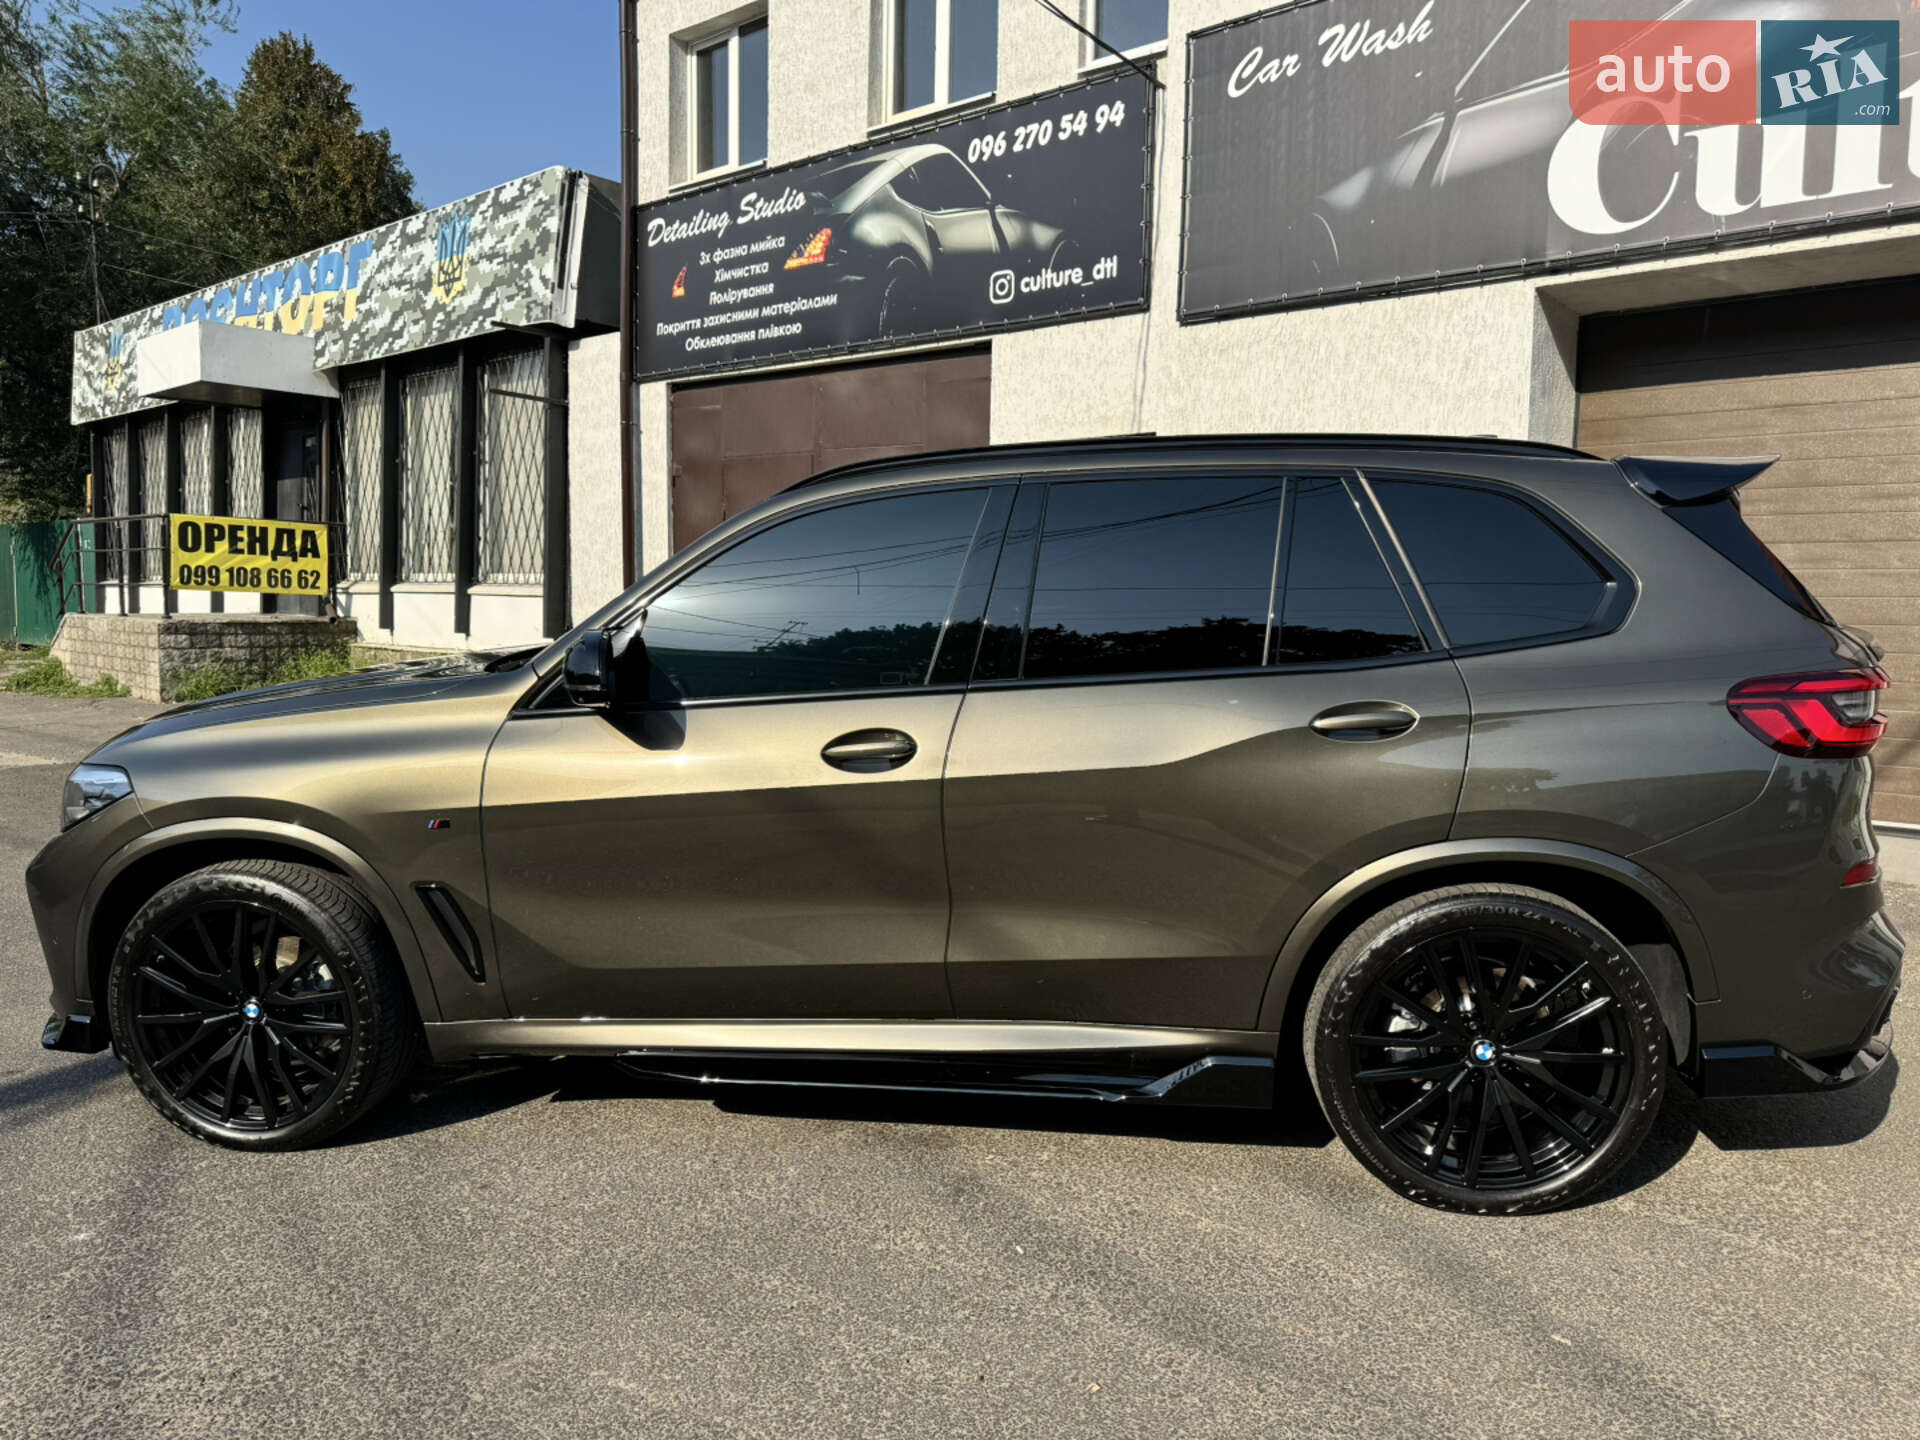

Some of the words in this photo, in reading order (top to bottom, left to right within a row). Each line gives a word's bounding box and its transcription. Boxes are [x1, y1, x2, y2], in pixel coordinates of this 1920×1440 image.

[1227, 46, 1301, 98] Car
[1318, 0, 1434, 67] Wash
[967, 130, 1007, 164] 096
[1012, 119, 1053, 152] 270
[1057, 109, 1088, 141] 54
[1094, 99, 1126, 134] 94
[647, 209, 733, 248] Detailing
[736, 186, 806, 225] Studio
[712, 243, 748, 264] фазна
[749, 235, 786, 254] мийка
[713, 262, 769, 283] Хімчистка
[1020, 254, 1118, 293] culture_dtl
[708, 282, 775, 306] Полірування
[656, 317, 702, 337] Покриття
[703, 305, 759, 328] захисними
[761, 293, 838, 317] матеріалами
[685, 329, 756, 351] Обклеювання
[757, 322, 803, 341] плівкою
[178, 521, 321, 562] ОРЕНДА
[179, 564, 220, 586] 099
[225, 566, 261, 588] 108
[266, 568, 292, 589] 66
[297, 569, 321, 590] 62
